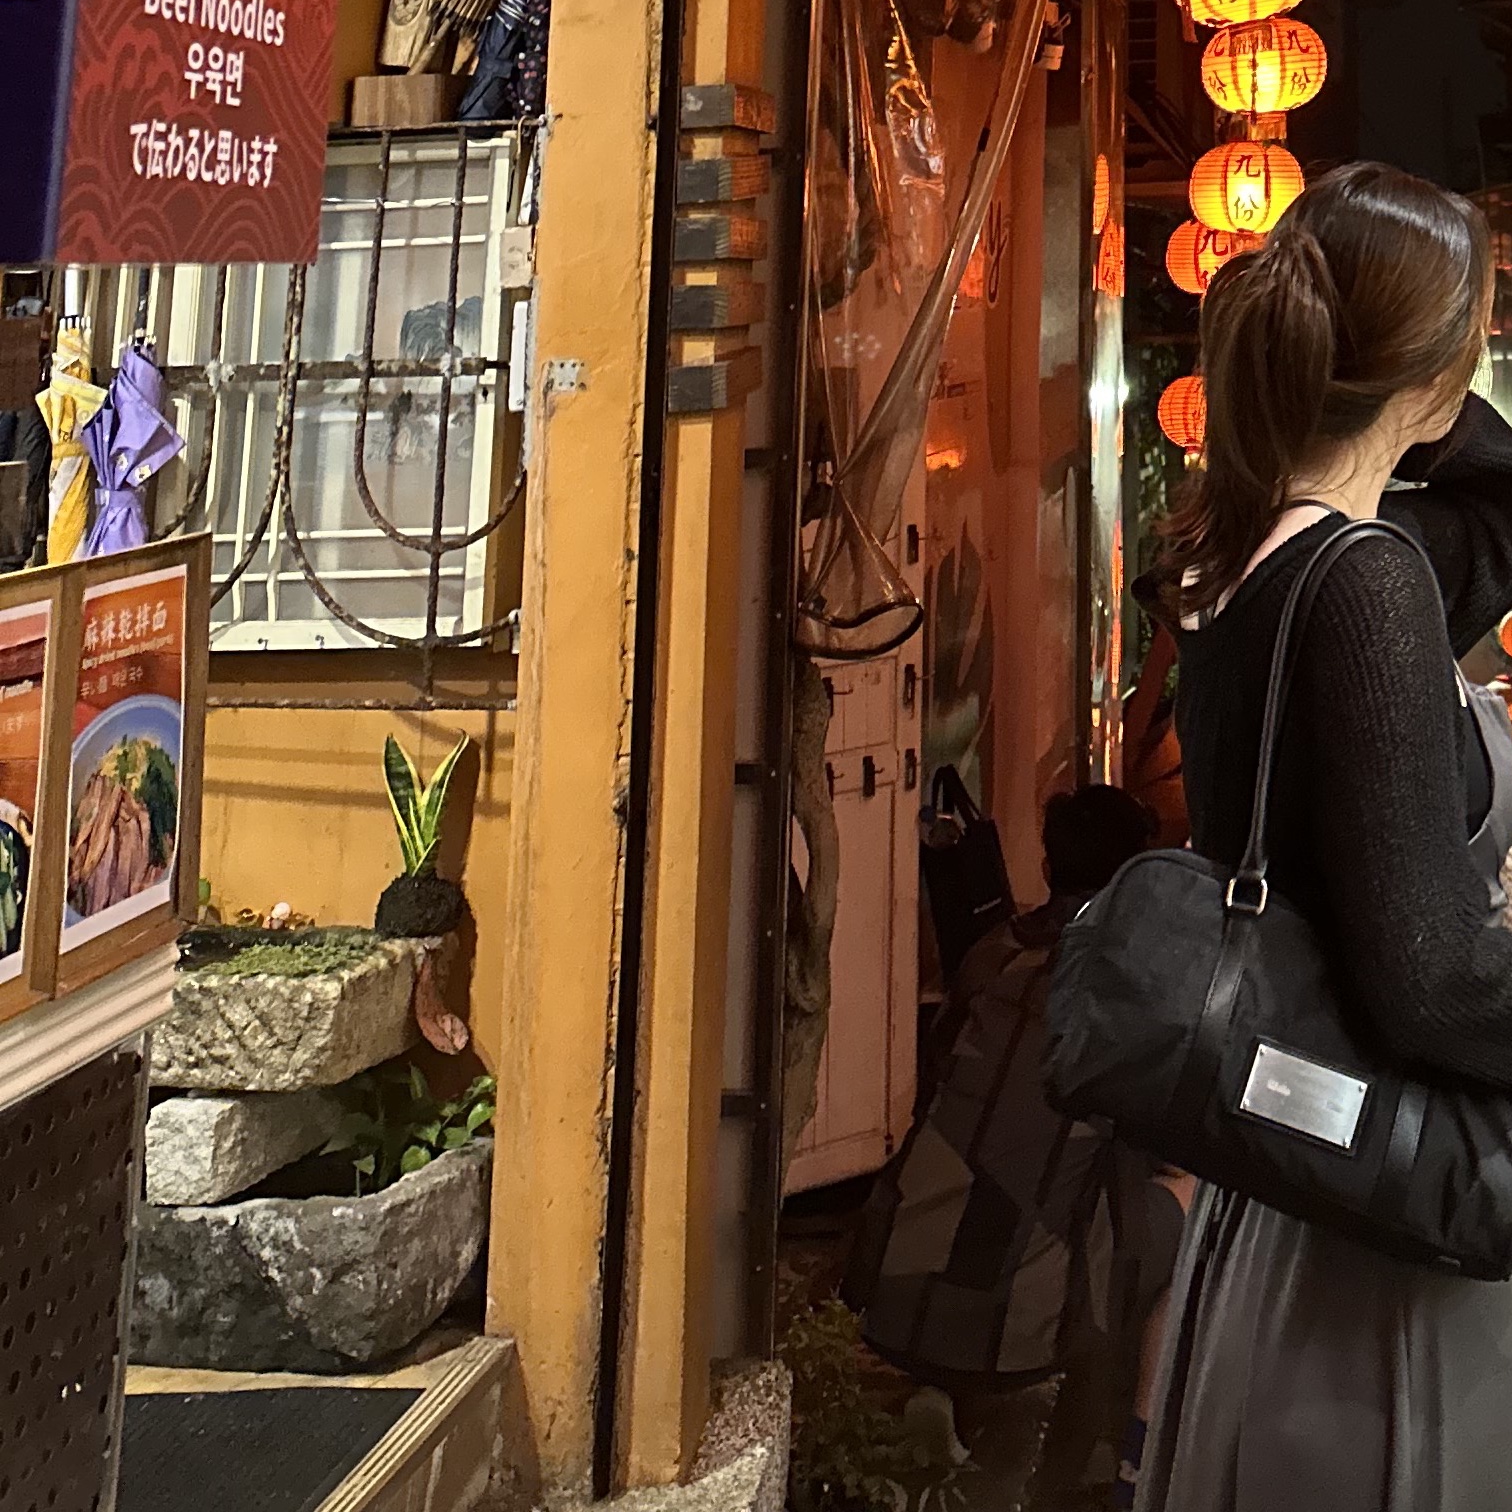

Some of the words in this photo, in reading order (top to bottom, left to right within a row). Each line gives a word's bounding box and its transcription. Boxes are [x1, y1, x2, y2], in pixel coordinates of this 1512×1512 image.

[184, 42, 244, 107] 우육면
[1287, 29, 1311, 96] 九份
[130, 119, 278, 188] で伝わると思います
[1233, 154, 1262, 222] 九份
